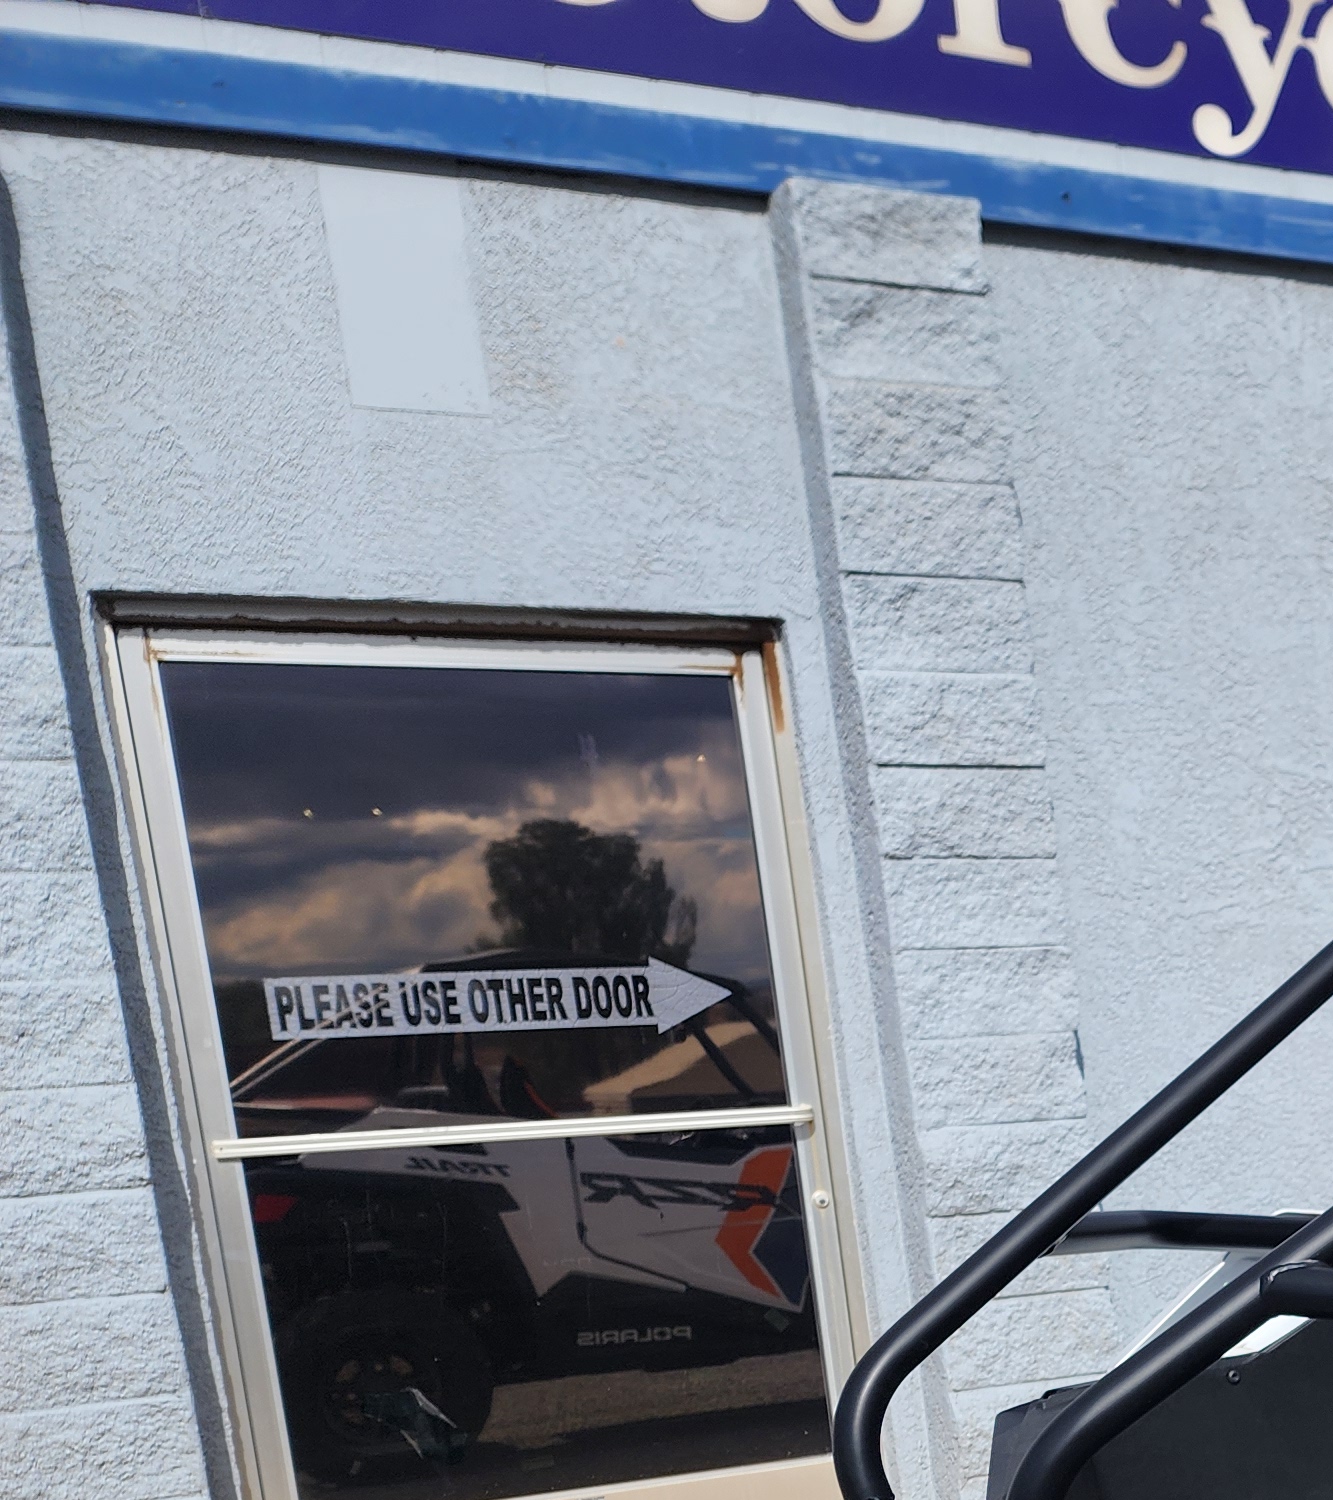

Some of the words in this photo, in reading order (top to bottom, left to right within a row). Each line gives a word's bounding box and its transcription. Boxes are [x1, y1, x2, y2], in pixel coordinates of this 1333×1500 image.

[273, 982, 393, 1033] PLEASE
[402, 980, 461, 1027] USE
[468, 977, 567, 1025] OTHER
[571, 974, 655, 1021] DOOR
